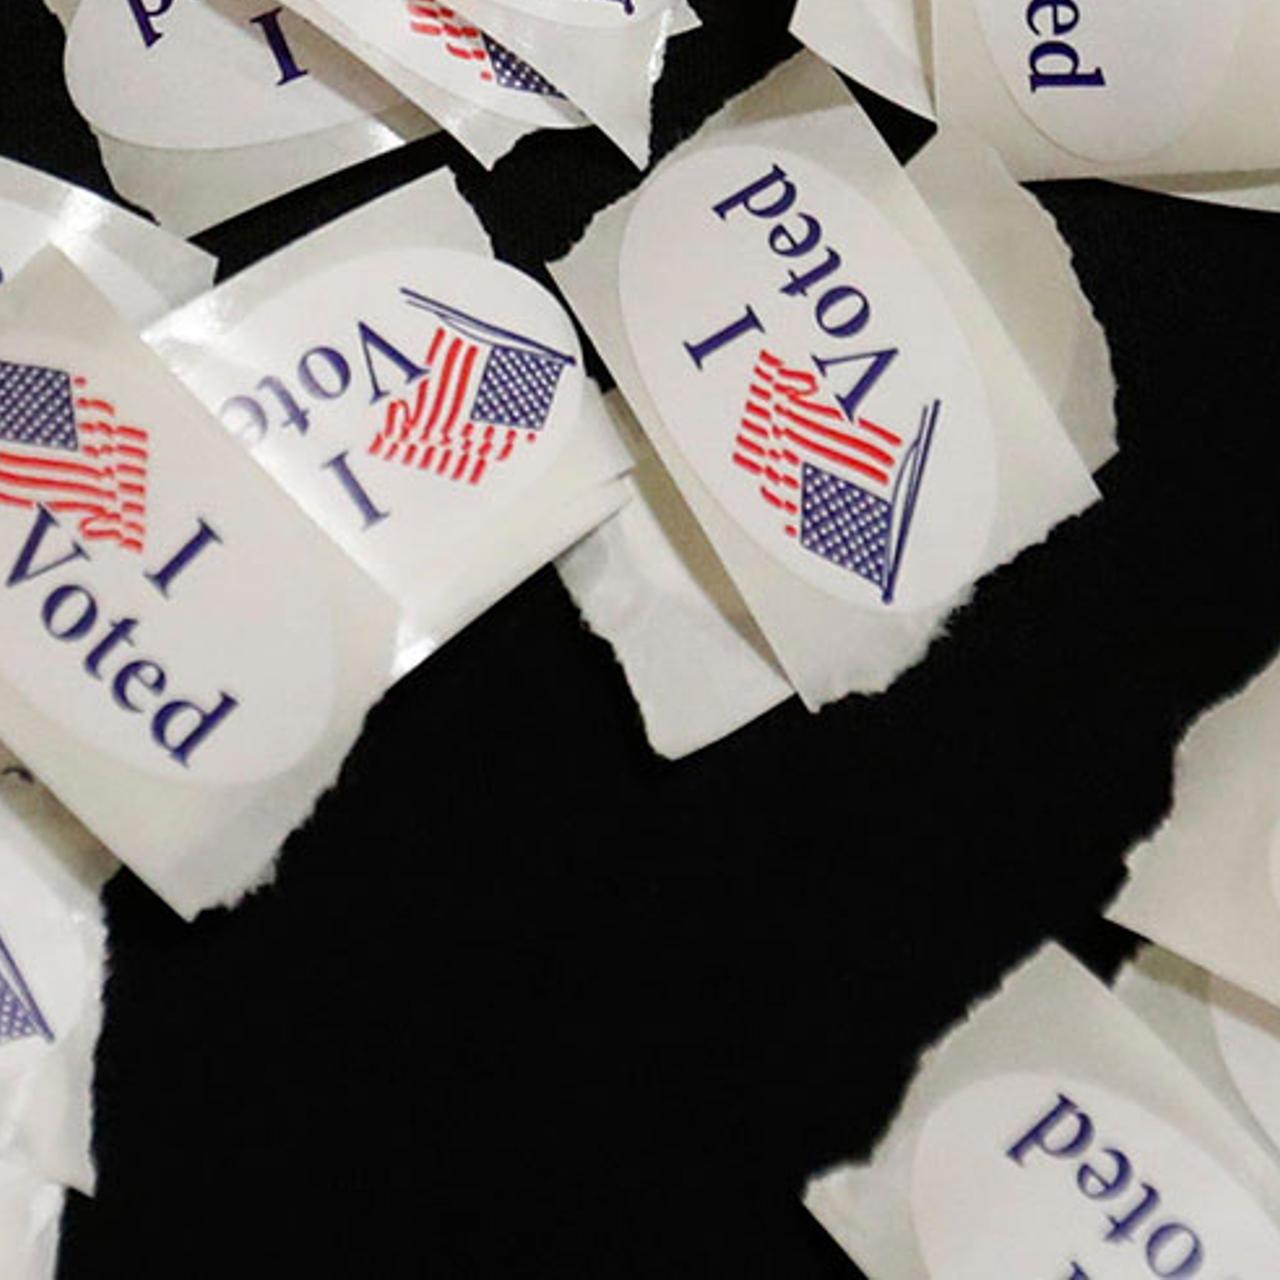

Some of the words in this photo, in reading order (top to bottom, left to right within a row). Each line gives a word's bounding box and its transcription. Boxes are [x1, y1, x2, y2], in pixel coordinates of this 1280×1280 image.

[249, 6, 310, 88] I
[711, 163, 900, 422] Voted
[682, 303, 766, 372] I
[320, 449, 391, 533] I
[142, 516, 226, 602] I
[4, 500, 240, 769] Voted
